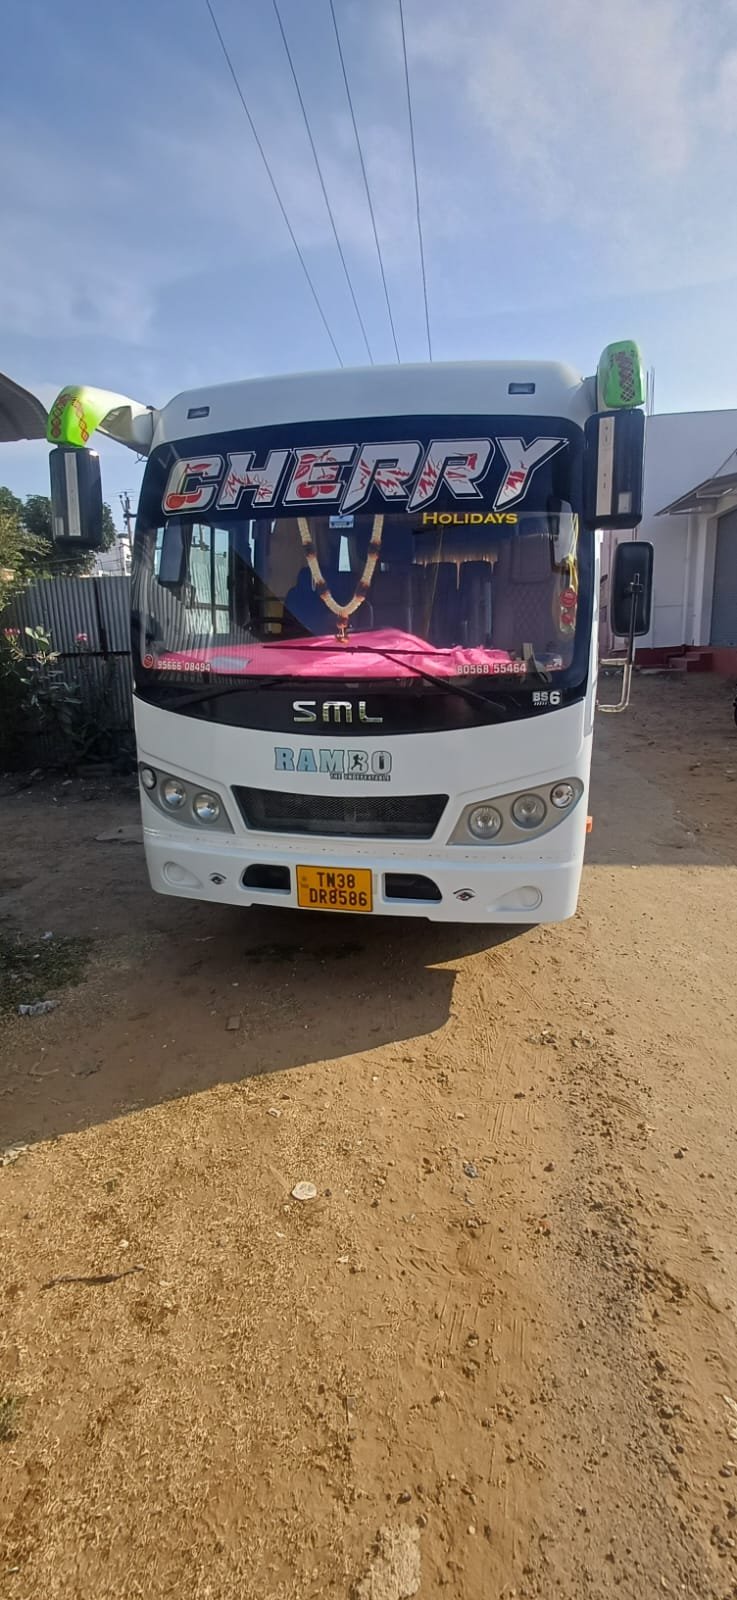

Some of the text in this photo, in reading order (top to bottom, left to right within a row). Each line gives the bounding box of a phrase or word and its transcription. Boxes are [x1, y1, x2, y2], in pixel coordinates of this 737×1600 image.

[161, 437, 569, 516] CHERRY
[422, 512, 518, 524] HOLIDAYS
[457, 663, 527, 674] 80568 55464
[293, 701, 384, 723] SML
[274, 747, 393, 774] RAMBO
[317, 872, 355, 889] TN38
[309, 888, 367, 906] DR8586
